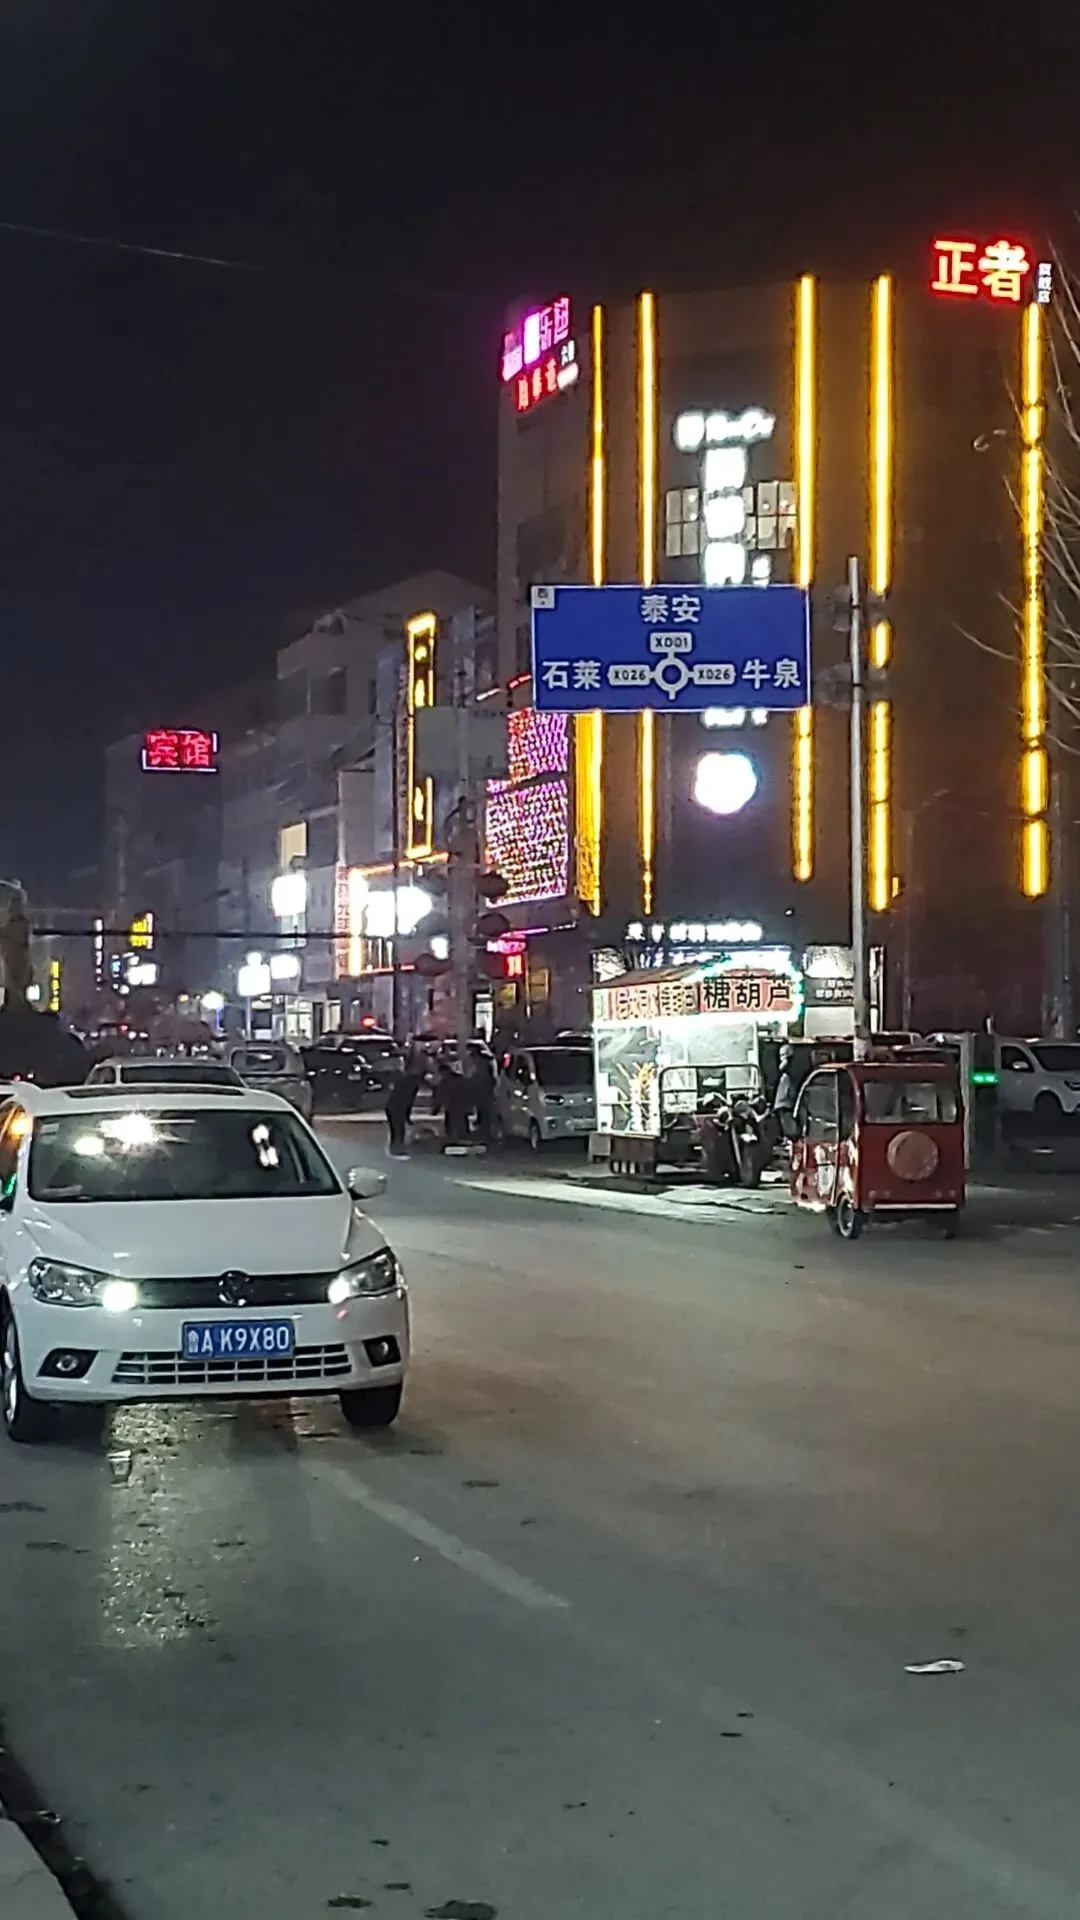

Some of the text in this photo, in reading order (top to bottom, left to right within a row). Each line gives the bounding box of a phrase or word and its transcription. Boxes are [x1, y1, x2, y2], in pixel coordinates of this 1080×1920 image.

[932, 239, 1029, 301] 正者
[641, 594, 701, 623] 泰安
[655, 637, 688, 648] X001
[542, 661, 601, 690] 石莱
[614, 668, 647, 681] X026
[697, 667, 730, 681] X026
[742, 658, 801, 690] 牛泉
[148, 731, 211, 766] 宾馆
[703, 974, 792, 1009] 糖葫芦
